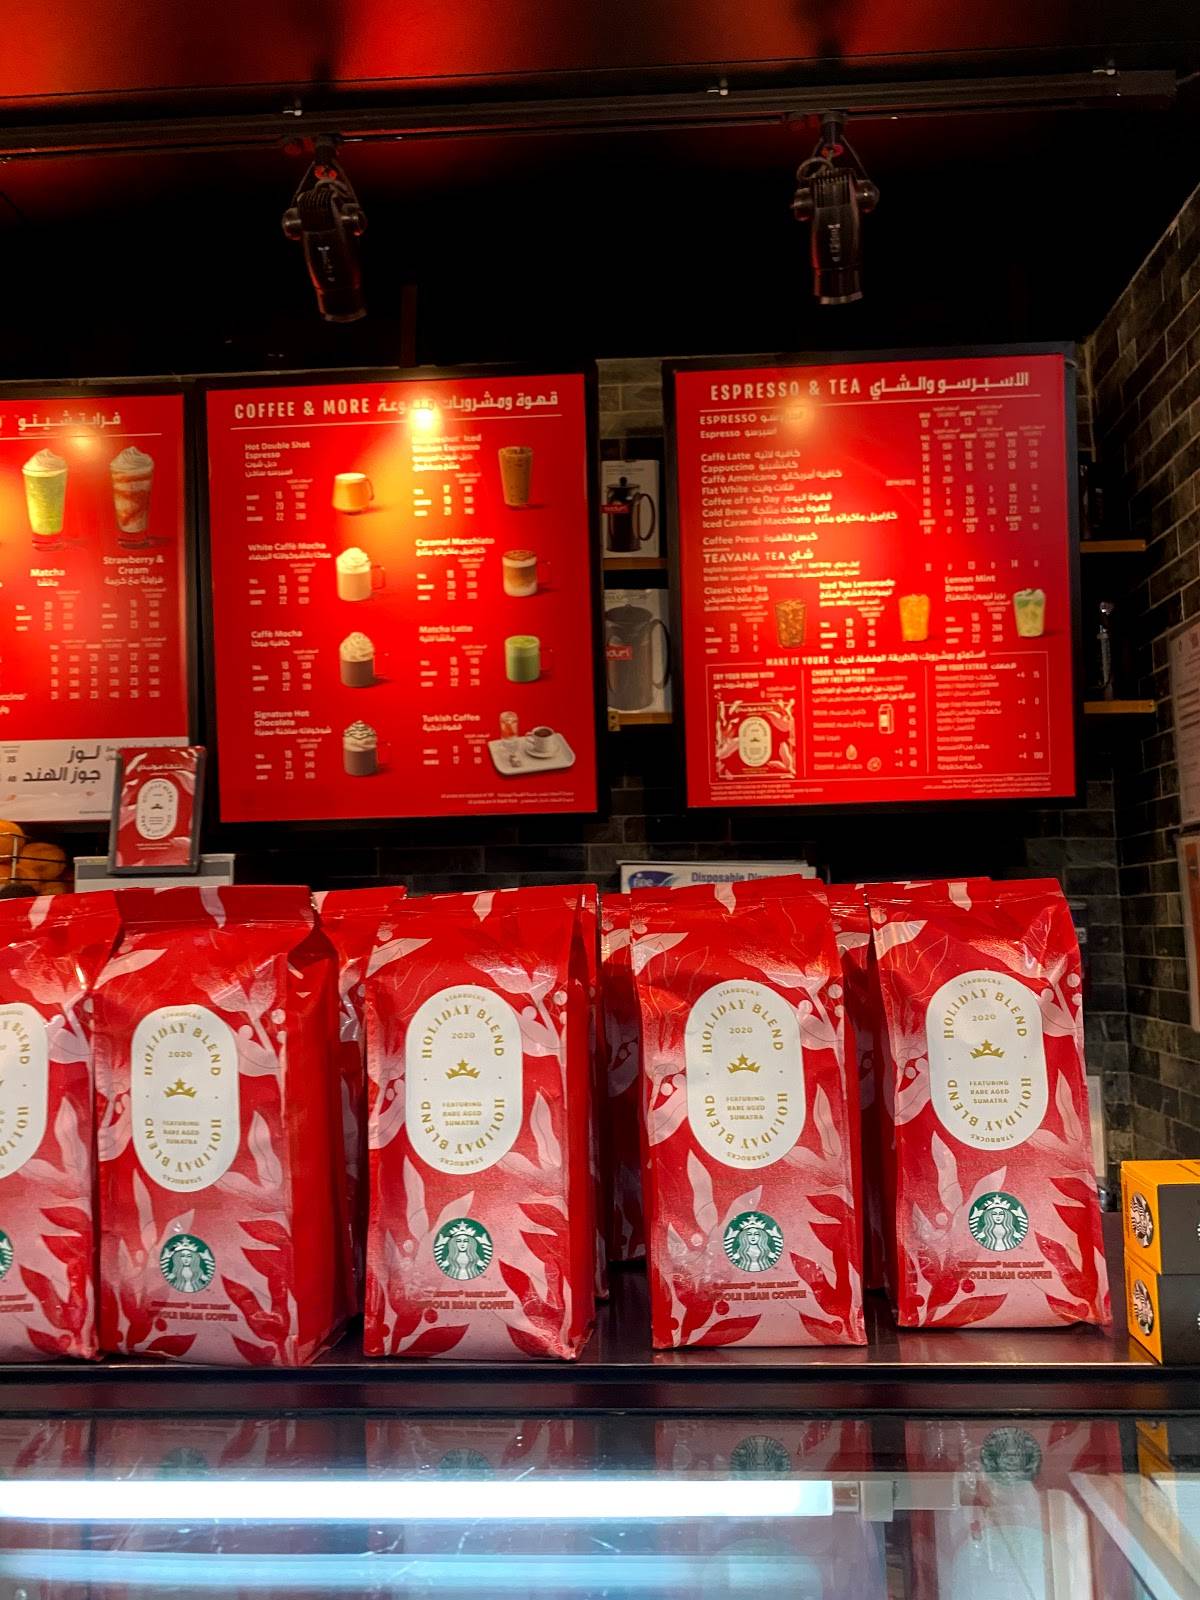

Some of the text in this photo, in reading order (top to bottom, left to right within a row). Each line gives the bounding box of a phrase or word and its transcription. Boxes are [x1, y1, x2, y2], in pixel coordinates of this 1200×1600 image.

[710, 378, 861, 401] ESPRESSO & TEA
[870, 372, 1029, 400] الاسبرسو والشاي
[516, 391, 559, 410] قهوة
[234, 398, 370, 419] COFFEE & MORE
[700, 413, 757, 425] ESPRESSO
[700, 429, 741, 439] Espresso
[262, 441, 290, 450] Double
[291, 440, 311, 449] Shot
[245, 451, 281, 460] Espresso
[727, 451, 751, 461] Latte
[701, 463, 755, 474] Cappuccino
[728, 472, 778, 483] Americano
[702, 485, 749, 495] Flat White
[702, 495, 780, 507] Coffee of the Day
[702, 508, 749, 518] Cold Brew
[702, 516, 811, 529] Iced Caramel Macchiato
[702, 535, 760, 546] Coffee Press
[248, 544, 273, 552] White
[103, 555, 164, 566] Strawberry &
[703, 551, 786, 564] TEAVANA TEA
[30, 568, 65, 578] Matcha
[118, 566, 149, 575] Cream
[945, 575, 996, 584] Lemon Mint
[274, 630, 303, 638] Mocha
[254, 710, 293, 719] Signature
[422, 713, 481, 722] Turkish Coffee
[254, 719, 296, 727] Chocolate
[67, 745, 102, 764] لوز
[22, 766, 101, 785] جوز الهند
[691, 872, 745, 883] Disposable
[943, 988, 1028, 1039] HOLIDAY BLEND
[971, 1013, 997, 1022] 2020
[421, 1004, 505, 1059] HOLIDAY BLEND
[702, 999, 784, 1054] HOLIDAY BLEND
[729, 1026, 753, 1035] 2020
[451, 1031, 476, 1040] 2020
[12, 1022, 31, 1065] BLEND
[144, 1022, 222, 1076] HOLIDAY BLEND
[168, 1051, 193, 1059] 2020
[969, 1079, 1009, 1087] FEATURING
[946, 1077, 1033, 1132] HOLIDAY BLEND
[973, 1097, 1008, 1105] SUMATRA
[704, 1092, 789, 1150] HOLIDAY BLEND
[729, 1113, 764, 1121] SUMATRA
[421, 1099, 505, 1155] HOLIDAY BLEND
[444, 1119, 480, 1127] SUMATRA
[144, 1117, 222, 1173] HOLIDAY BLEND
[1017, 1270, 1053, 1279] COFFEE
[771, 1289, 807, 1299] COFFEE
[479, 1301, 514, 1310] COFFEE
[205, 1312, 238, 1321] COFFEE
